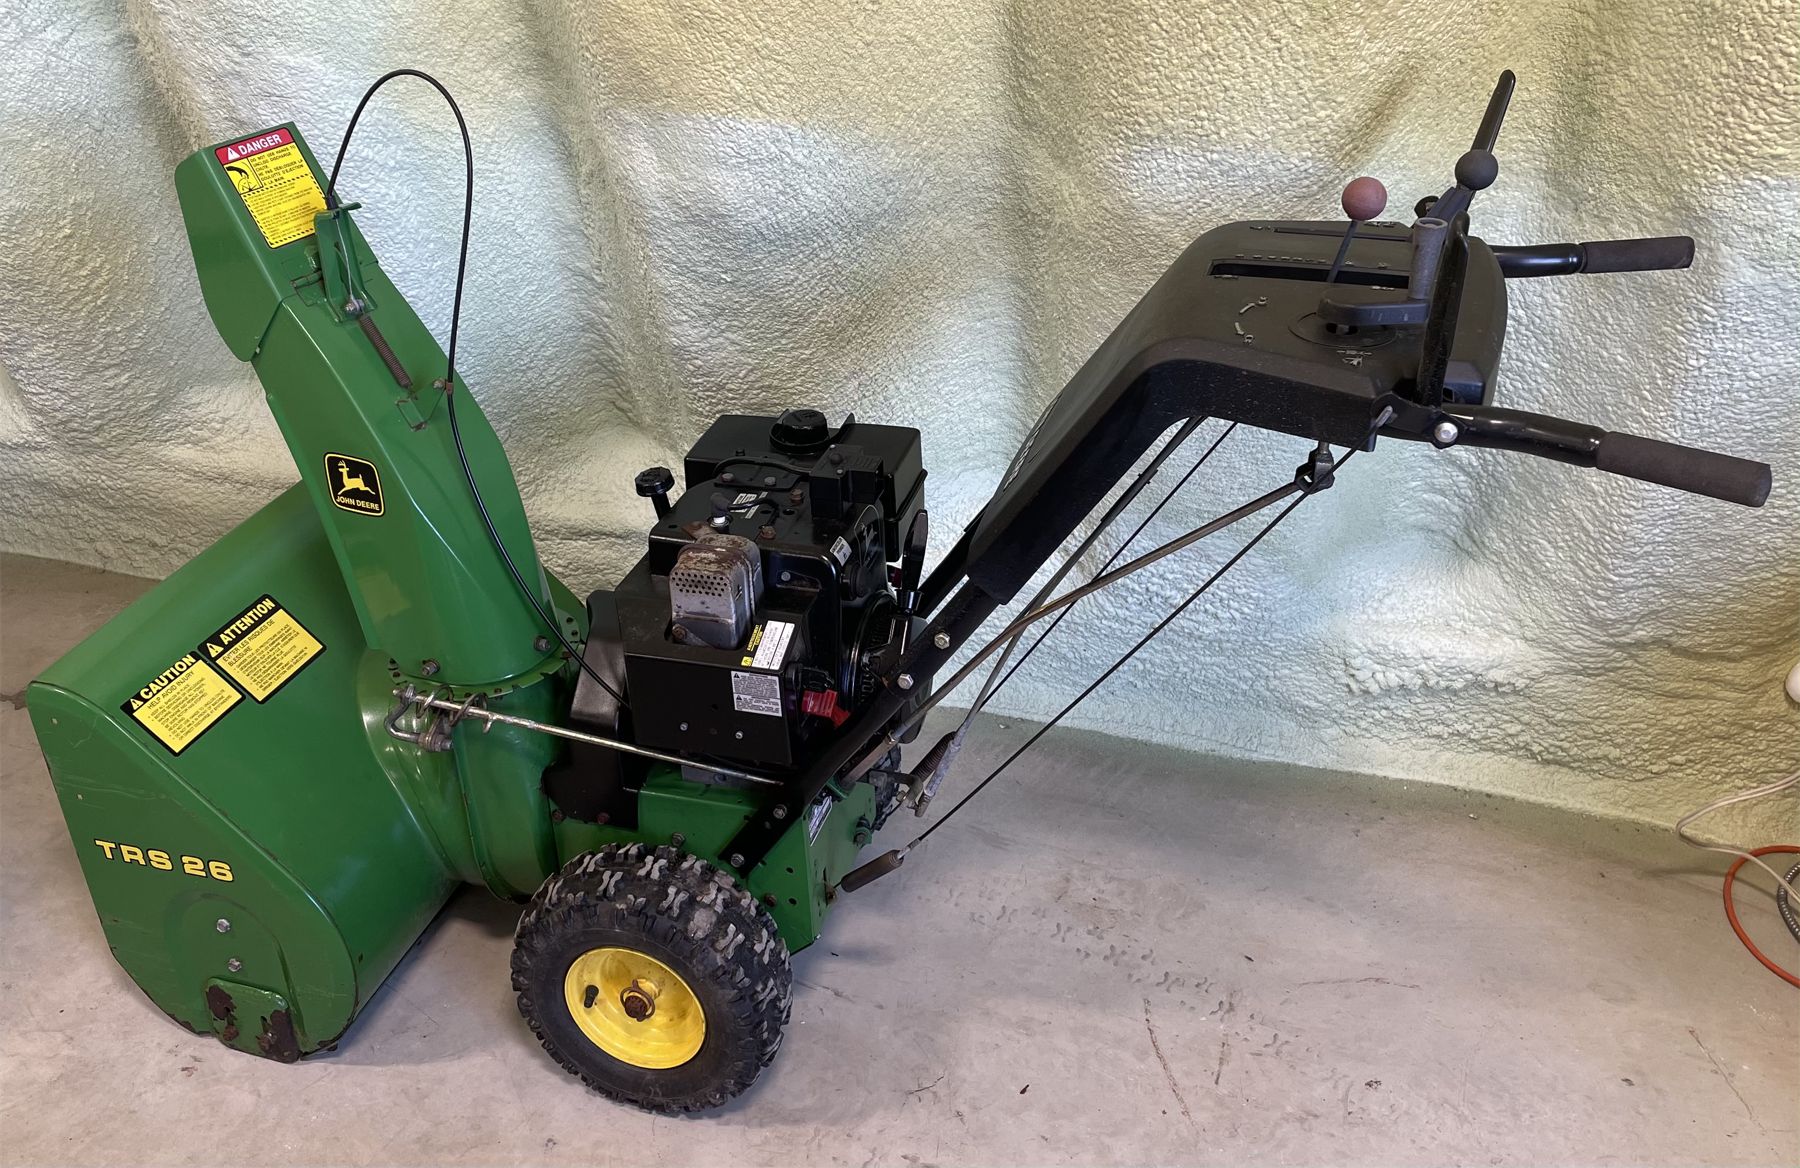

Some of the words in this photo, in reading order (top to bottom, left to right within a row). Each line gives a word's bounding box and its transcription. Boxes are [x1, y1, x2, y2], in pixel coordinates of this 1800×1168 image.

[238, 134, 282, 155] DANGER
[336, 496, 355, 505] JOHN
[356, 500, 380, 510] DEERE
[219, 597, 276, 646] ATTENTION
[237, 639, 249, 649] LES
[246, 623, 268, 642] RISQUES
[265, 618, 275, 626] DE
[227, 645, 252, 667] BLESSURE
[139, 654, 196, 700] CAUTION
[146, 696, 162, 710] HELP
[160, 684, 177, 698] AVOID
[175, 670, 195, 686] INJURY
[94, 839, 173, 871] TRS
[181, 855, 234, 882] 26
